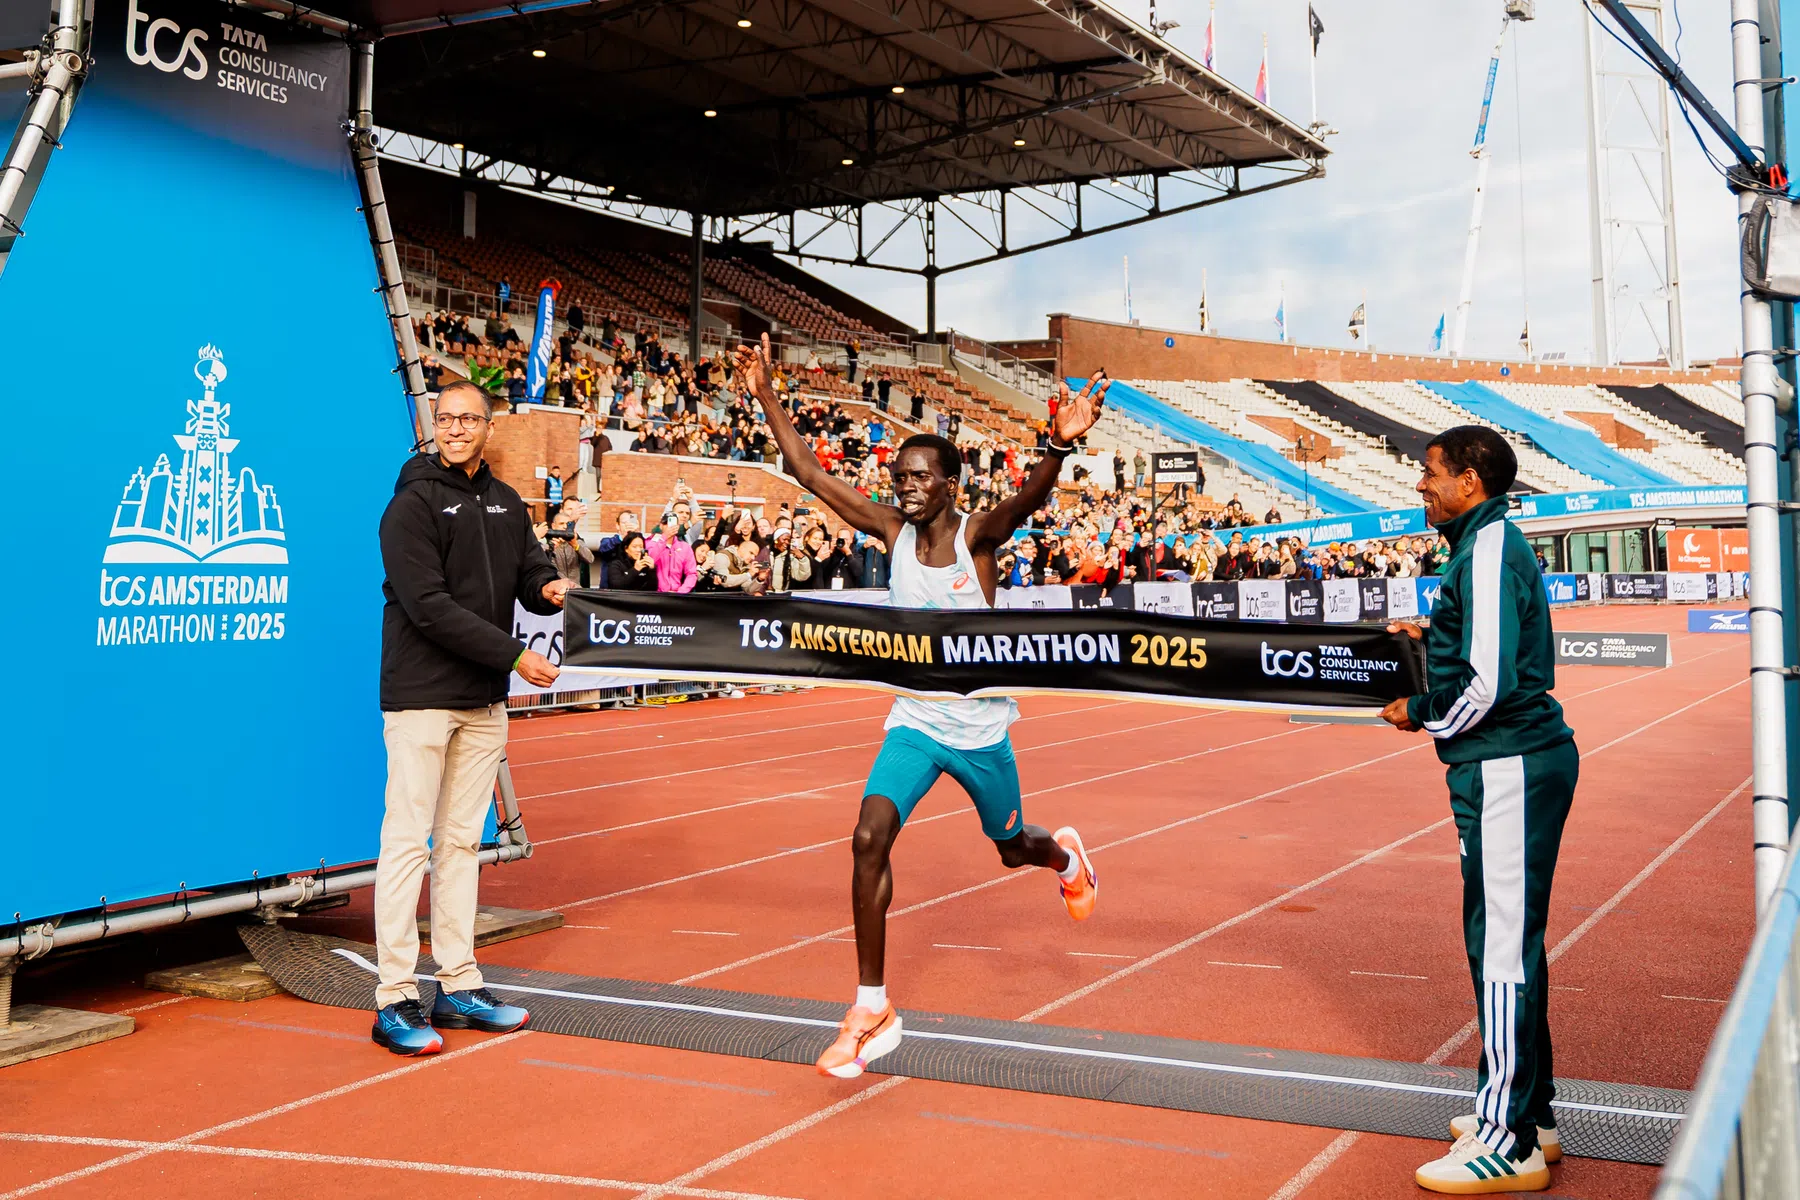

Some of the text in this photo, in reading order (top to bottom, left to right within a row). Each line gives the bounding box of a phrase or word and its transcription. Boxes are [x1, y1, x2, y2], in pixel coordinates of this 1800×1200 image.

[126, 0, 209, 80] tcs
[220, 22, 268, 52] TATA
[218, 46, 328, 92] CONSULTANCY
[217, 69, 288, 104] SERVICES
[1629, 489, 1744, 508] TCS AMSTERDAM MARATHON
[100, 568, 289, 606] tcs AMSTERDAM
[1614, 578, 1634, 595] tcs
[590, 612, 631, 644] tcs
[636, 614, 662, 624] TATA
[97, 612, 285, 646] MARATHON 2025
[634, 624, 695, 636] CONSULTANCY
[634, 635, 672, 646] SERVICES
[739, 618, 1207, 668] TCS AMSTERDAM MARATHON 2025
[1560, 637, 1598, 657] tcs
[1601, 645, 1656, 653] CONSULTANCY
[1261, 641, 1314, 678] tcs
[1318, 645, 1353, 656] TATA
[1601, 651, 1637, 659] SERVICES
[1319, 657, 1398, 672] CONSULTANCY
[1320, 669, 1370, 682] SERVICES
